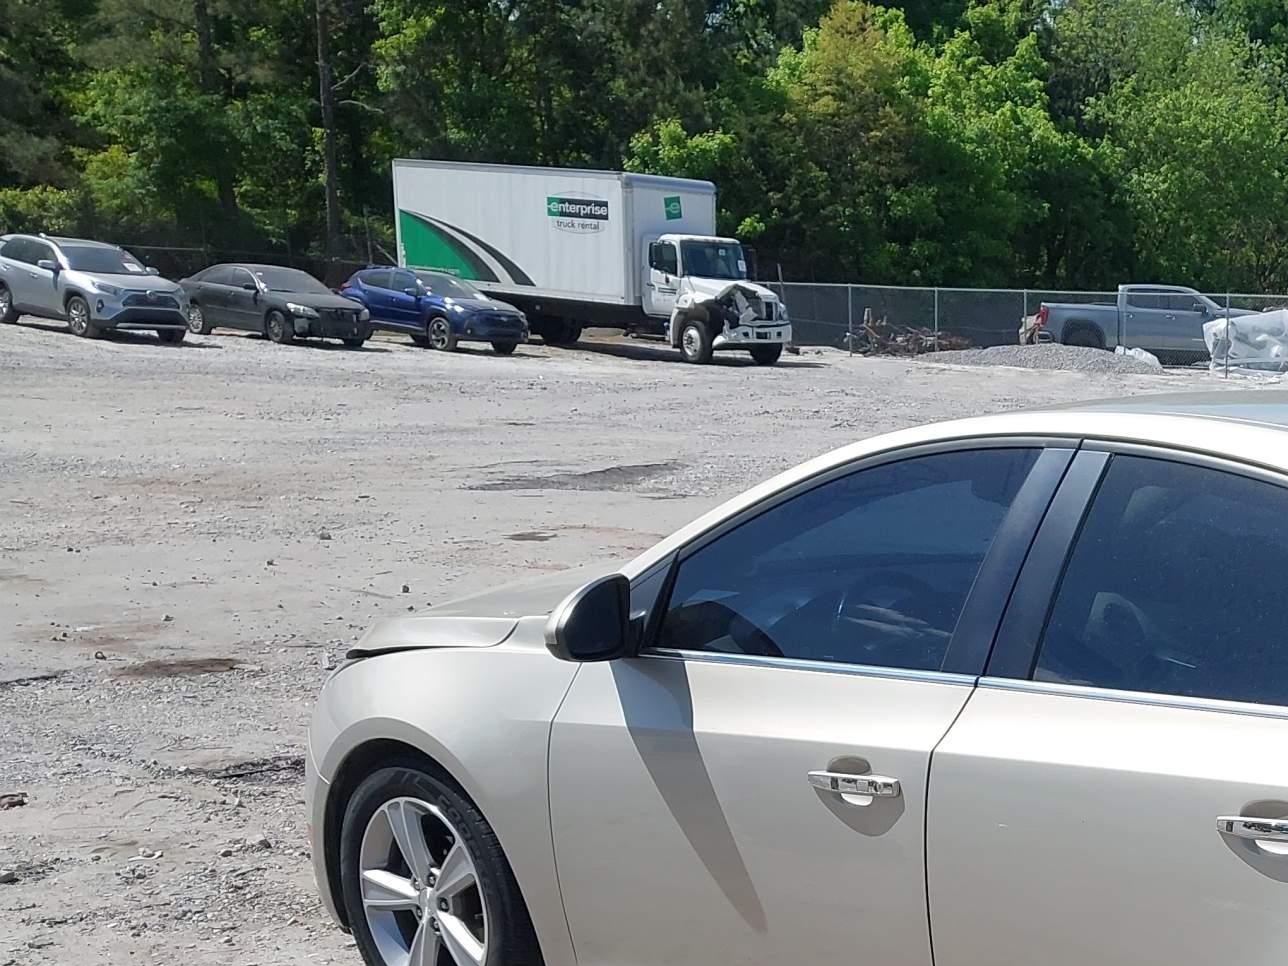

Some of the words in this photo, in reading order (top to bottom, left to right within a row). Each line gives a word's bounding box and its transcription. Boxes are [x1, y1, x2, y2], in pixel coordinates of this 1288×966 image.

[547, 200, 608, 216] enterprise
[556, 219, 576, 229] truck
[577, 221, 600, 230] rental
